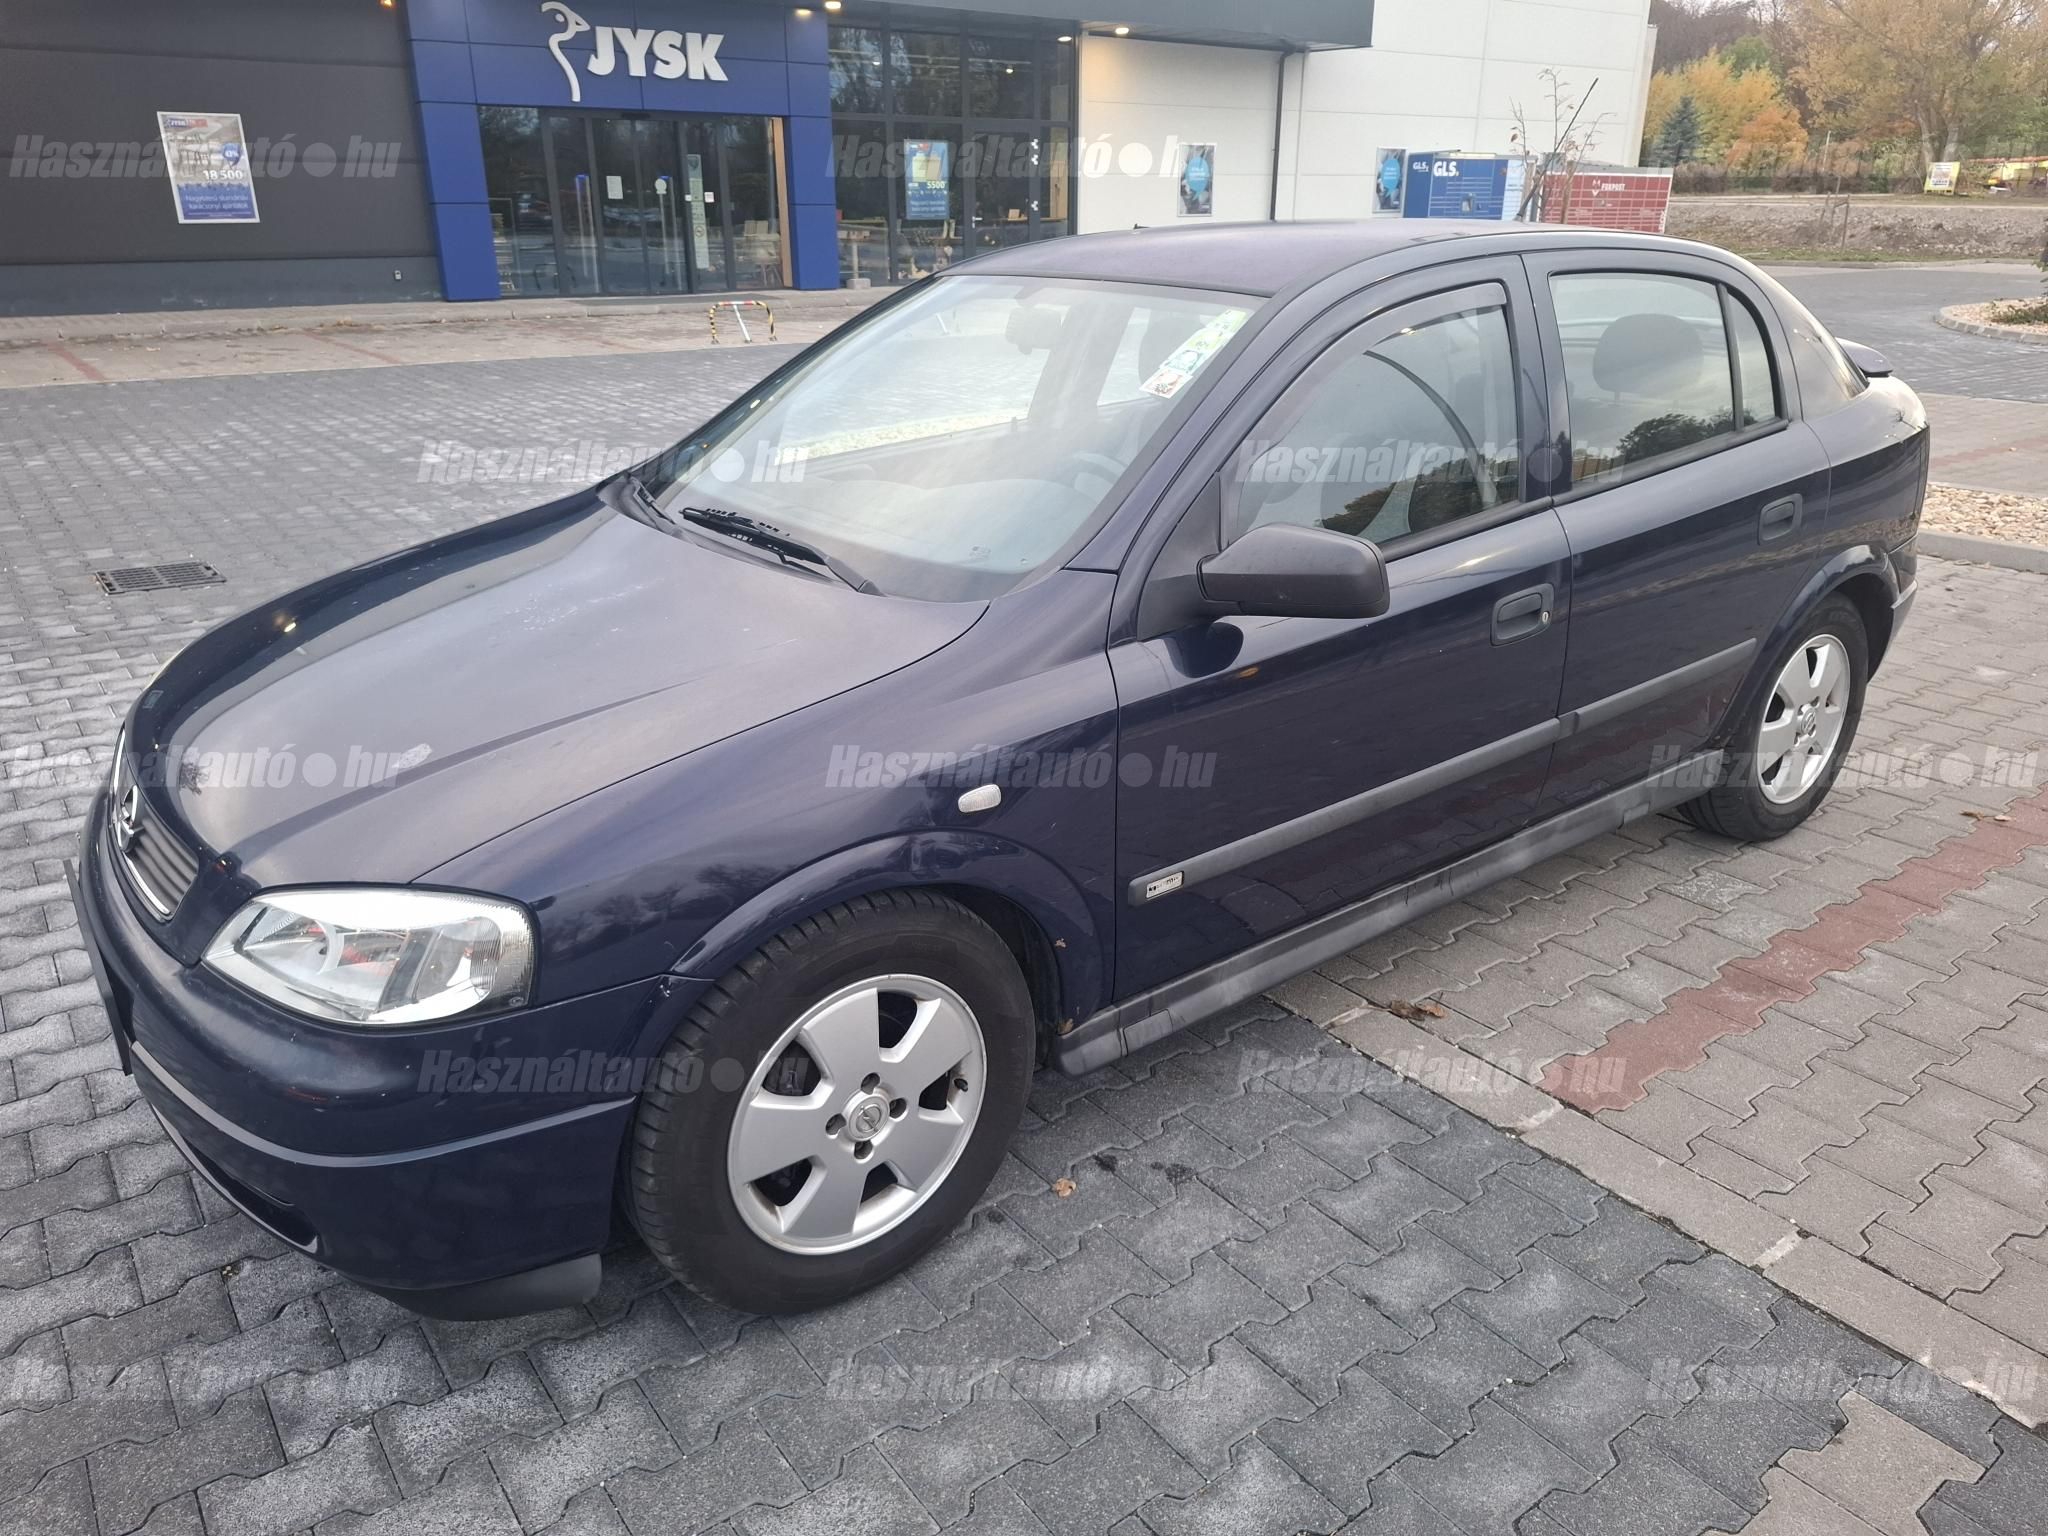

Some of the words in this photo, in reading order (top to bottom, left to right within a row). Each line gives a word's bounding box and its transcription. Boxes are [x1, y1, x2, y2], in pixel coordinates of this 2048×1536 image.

[587, 26, 728, 81] JYSK
[203, 170, 218, 180] 18
[220, 170, 243, 180] 500
[926, 181, 945, 189] 5500
